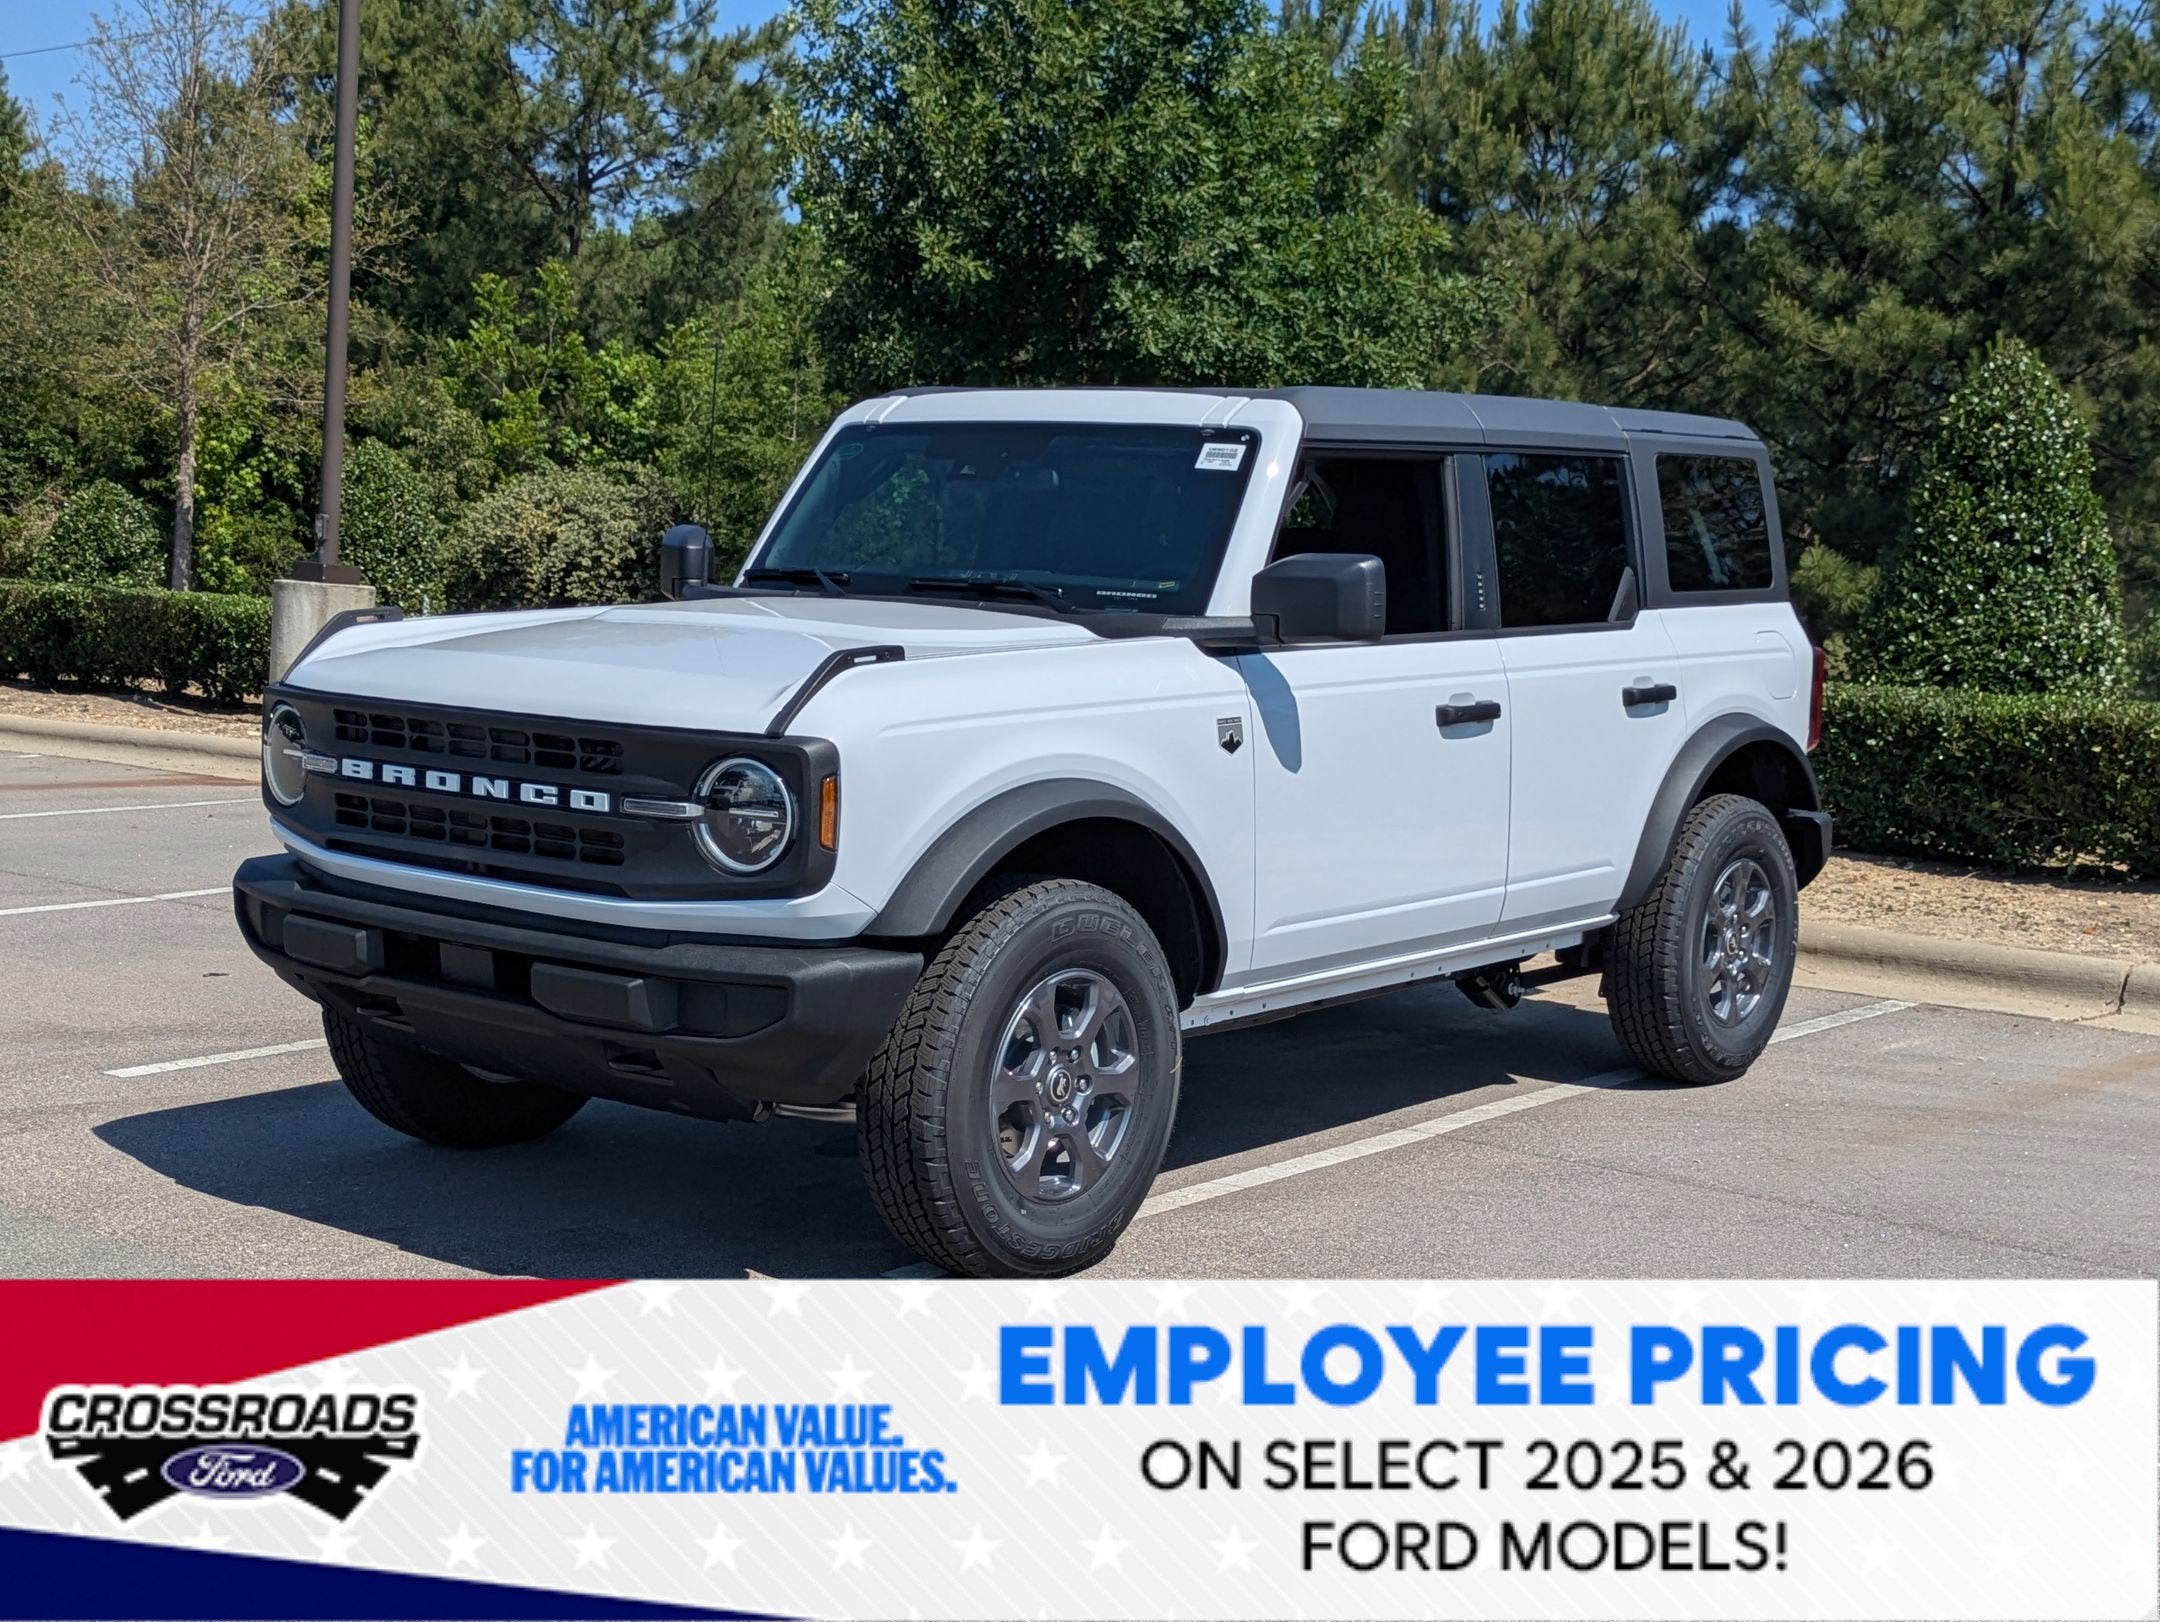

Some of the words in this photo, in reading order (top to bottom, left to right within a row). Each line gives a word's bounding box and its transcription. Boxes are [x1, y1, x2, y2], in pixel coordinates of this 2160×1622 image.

[341, 757, 611, 813] BRONCO
[1050, 913, 1168, 993] DUELER
[962, 1158, 1127, 1261] BRIDGESTONE
